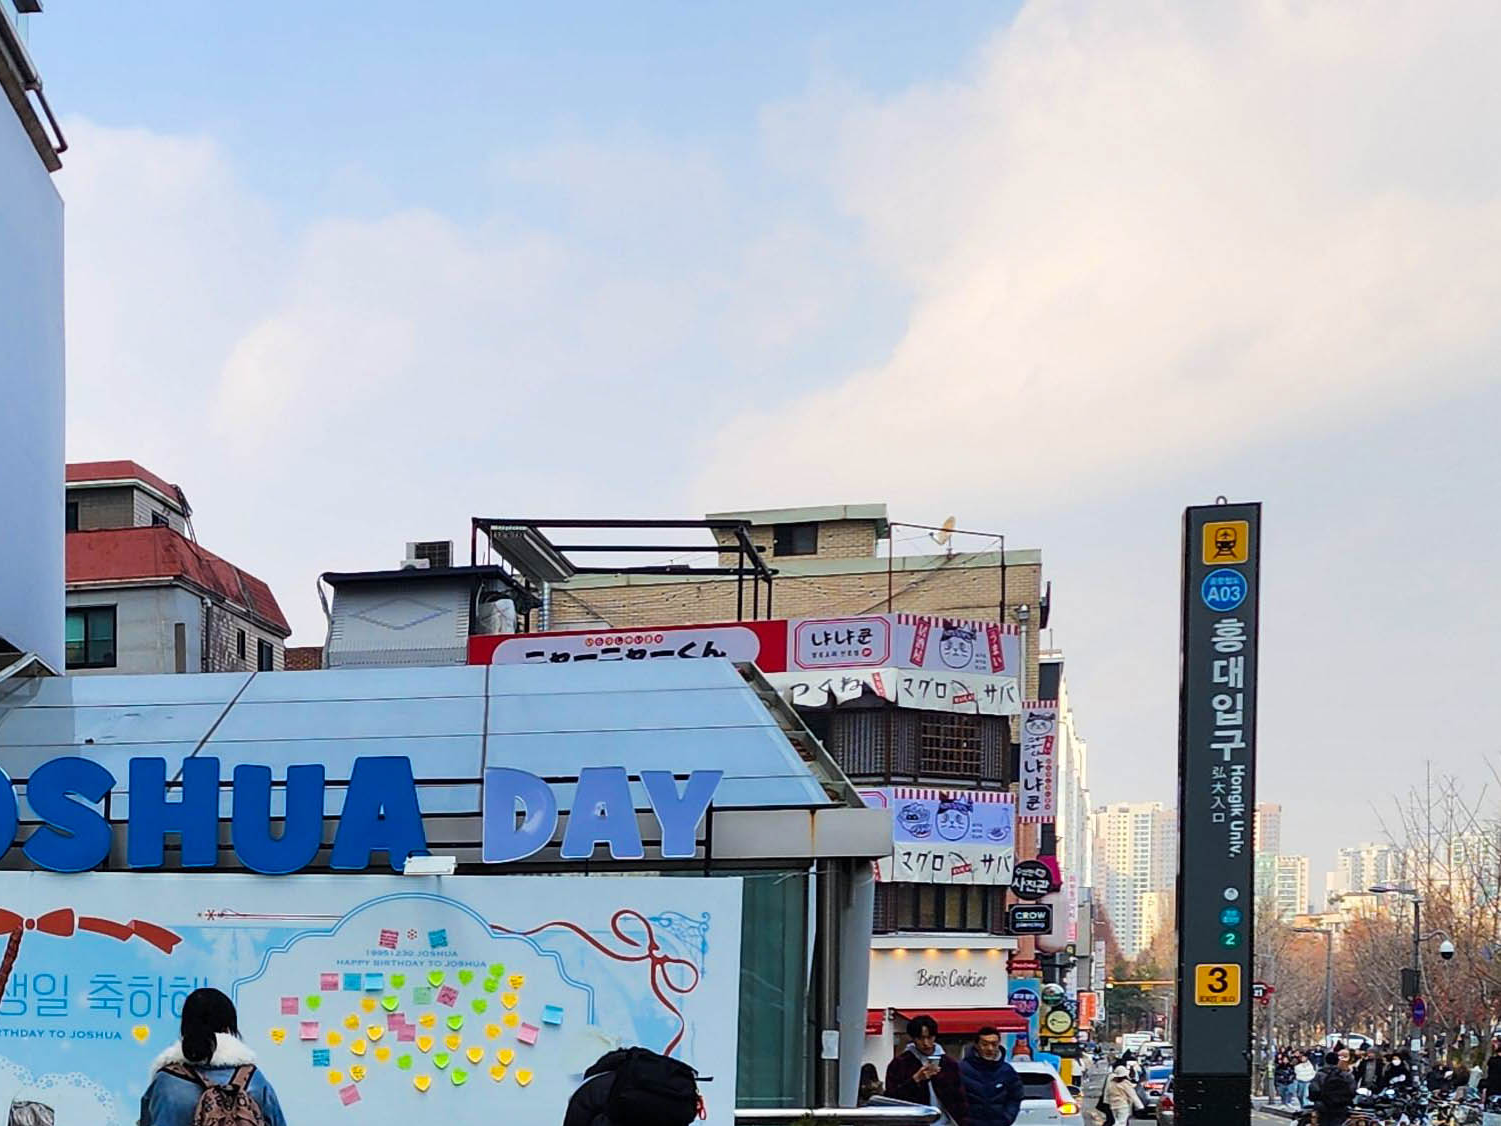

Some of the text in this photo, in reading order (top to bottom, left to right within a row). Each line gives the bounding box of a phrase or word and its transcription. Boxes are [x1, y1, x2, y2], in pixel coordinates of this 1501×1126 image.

[1207, 586, 1241, 602] A03
[903, 676, 947, 699] マグロ
[984, 681, 1015, 704] サバ
[1210, 618, 1247, 762] 홍대입구
[1210, 766, 1227, 822] 弘大入口
[1227, 765, 1246, 817] Hongik
[482, 765, 724, 864] DAY
[902, 850, 945, 872] マグロ
[980, 853, 1012, 874] サバ
[1011, 877, 1050, 894] 사진관
[1015, 911, 1047, 920] CROW
[1225, 932, 1236, 946] 2
[373, 960, 425, 968] BIRTHDAY
[445, 961, 487, 969] JOSHUA
[916, 968, 988, 988] Ben's Cookies
[1207, 966, 1229, 994] 3
[49, 1029, 66, 1038] TO
[70, 1030, 123, 1040] JOSHUA
